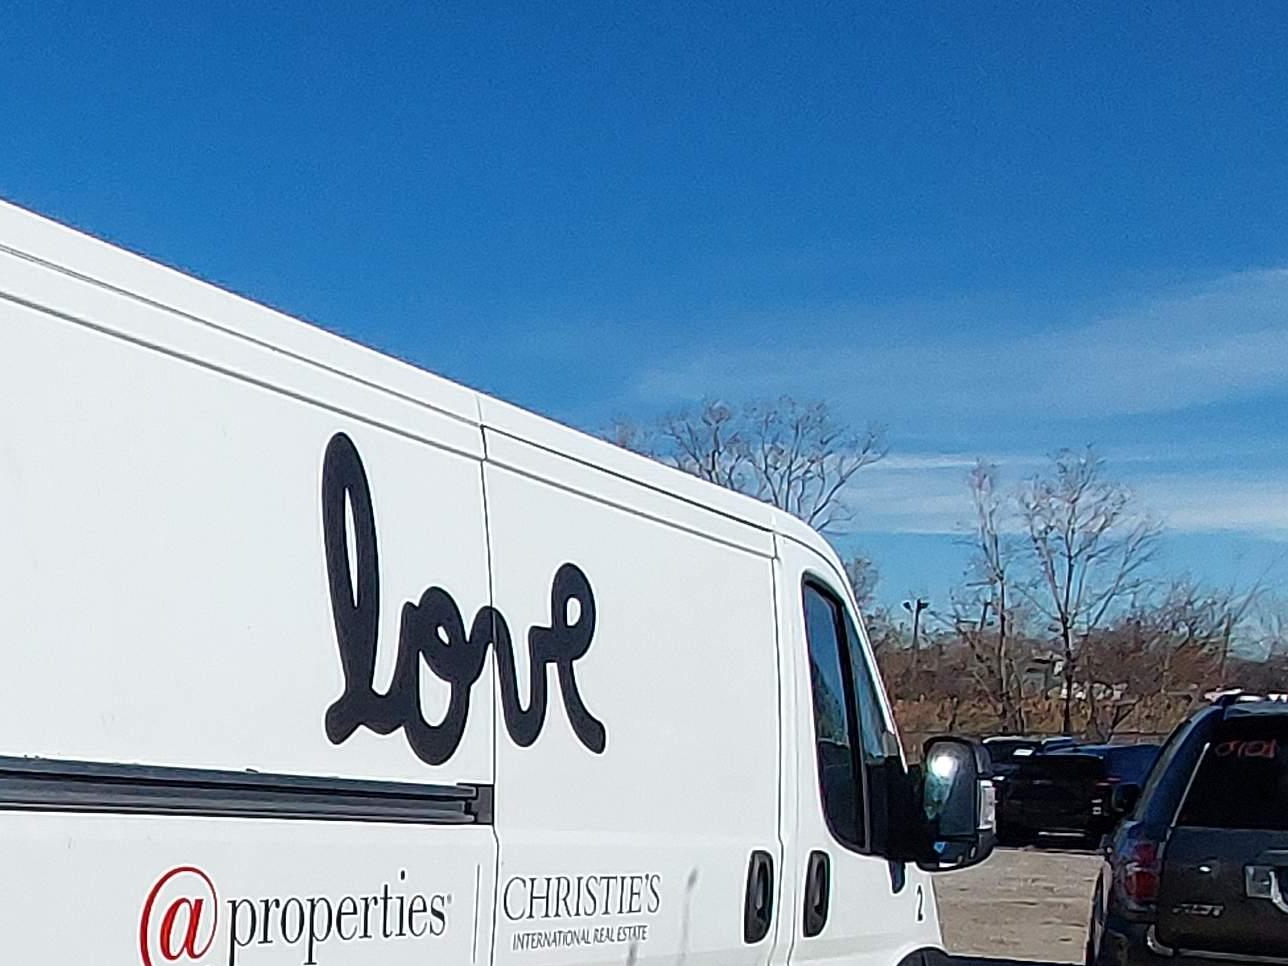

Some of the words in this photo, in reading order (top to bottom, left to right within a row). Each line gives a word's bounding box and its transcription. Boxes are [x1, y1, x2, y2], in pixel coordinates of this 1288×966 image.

[322, 432, 606, 766] love
[503, 873, 661, 920] CHRISTIE'S
[512, 929, 591, 950] INTERNATIONAL
[593, 926, 616, 943] REAL
[617, 925, 648, 942] ESTATE
